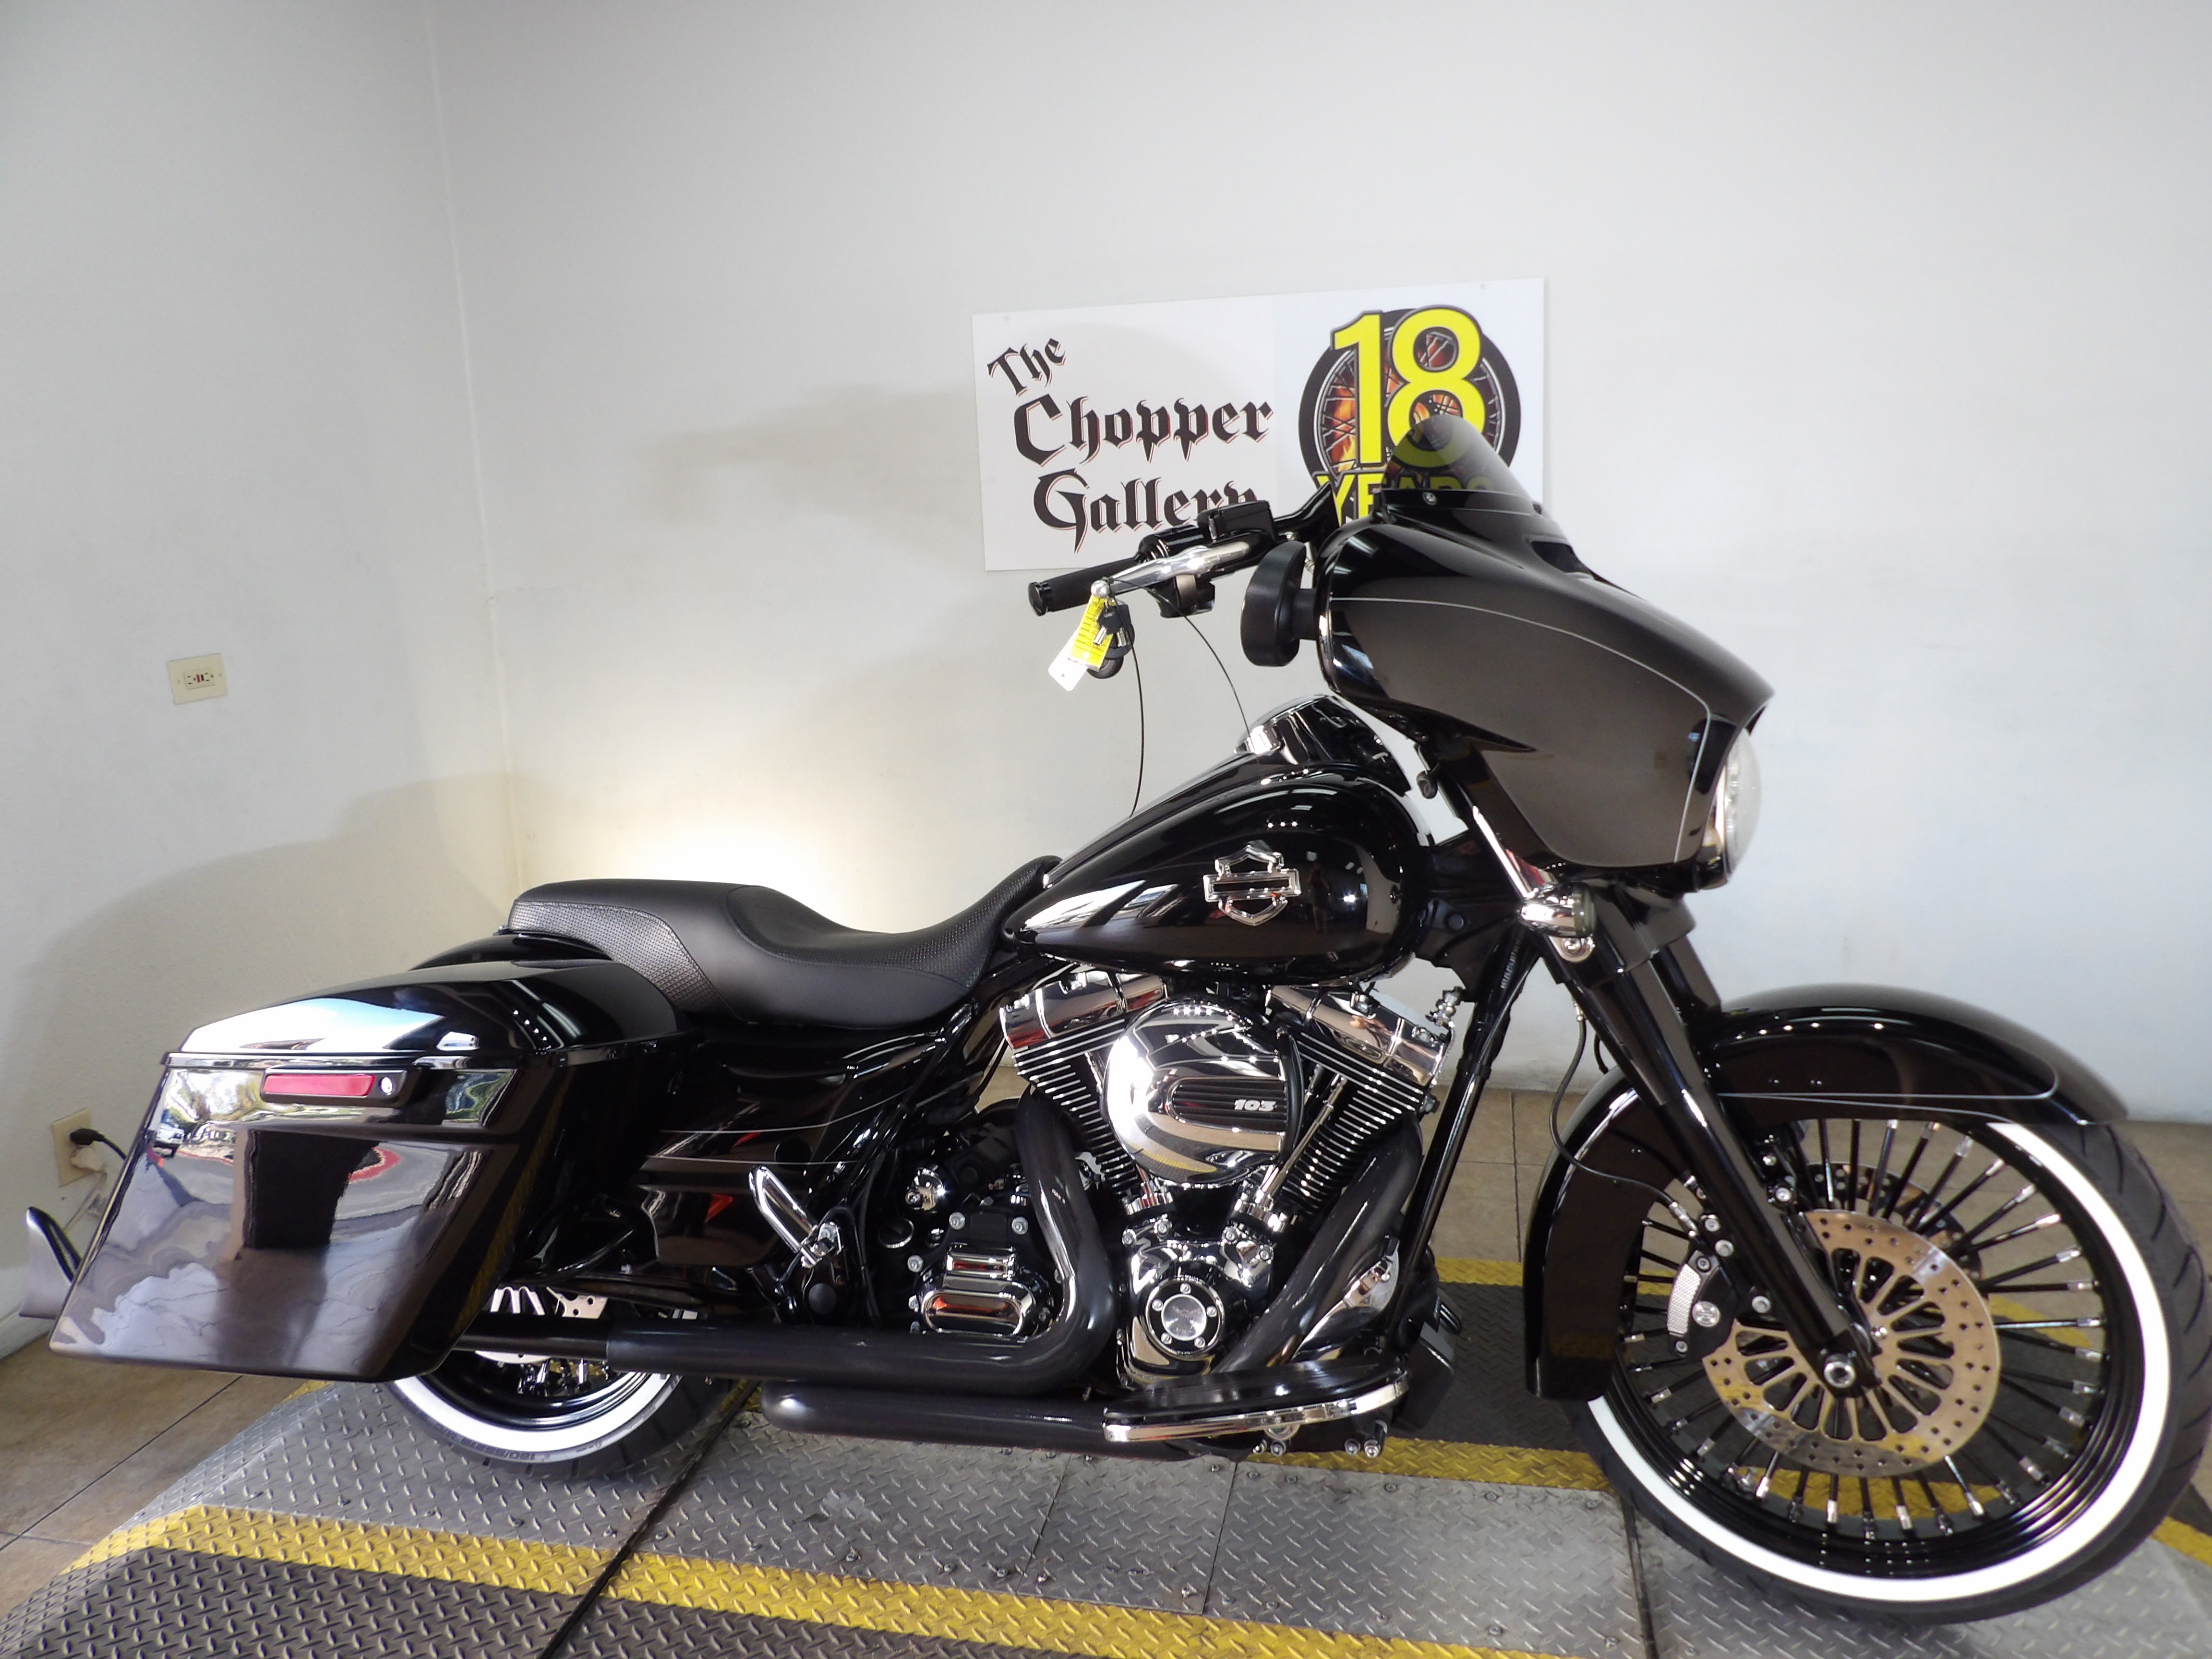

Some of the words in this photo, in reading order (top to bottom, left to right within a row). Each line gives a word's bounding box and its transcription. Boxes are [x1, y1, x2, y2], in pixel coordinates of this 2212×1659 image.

[987, 338, 1067, 397] The
[1331, 304, 1487, 469] 18
[1014, 393, 1274, 467] Chopper
[1234, 1099, 1276, 1112] 103
